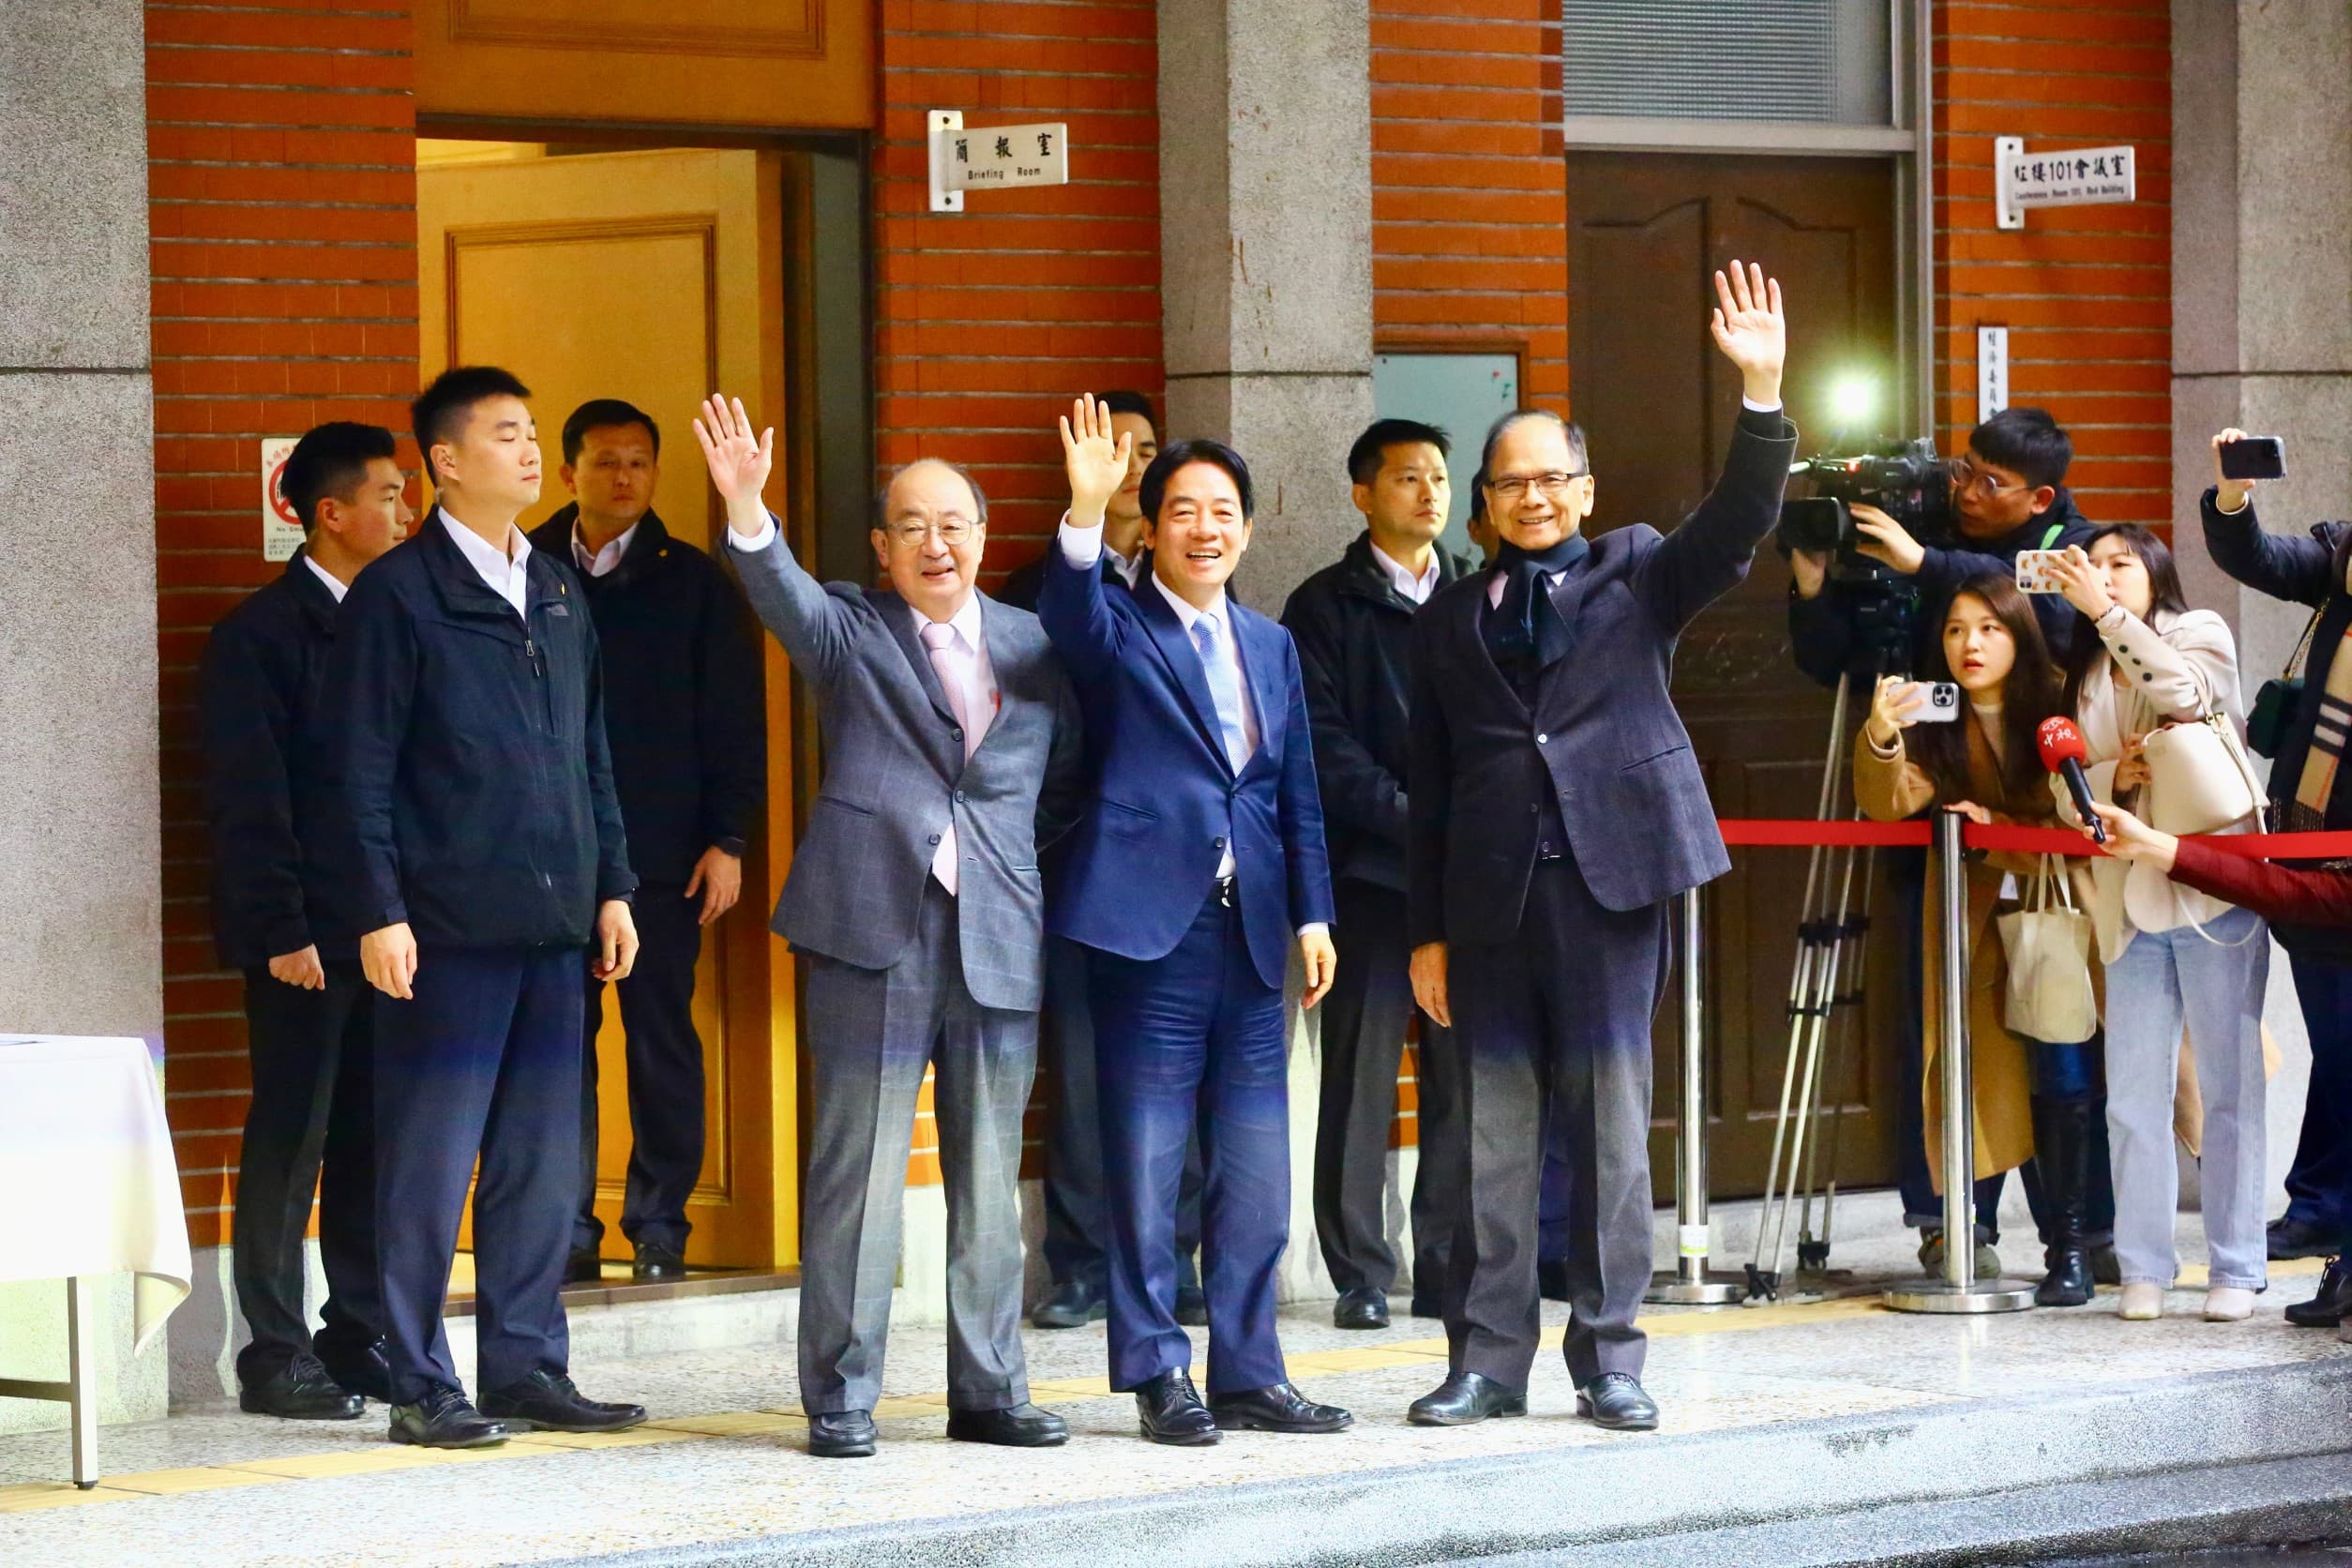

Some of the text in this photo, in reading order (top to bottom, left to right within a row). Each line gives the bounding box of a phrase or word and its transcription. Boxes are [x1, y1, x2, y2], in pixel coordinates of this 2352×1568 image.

[955, 132, 1052, 163] 簡報室
[968, 167, 1041, 180] Briefing Room
[2014, 154, 2125, 182] 紅樓101會議室
[2043, 728, 2077, 748] 中視
